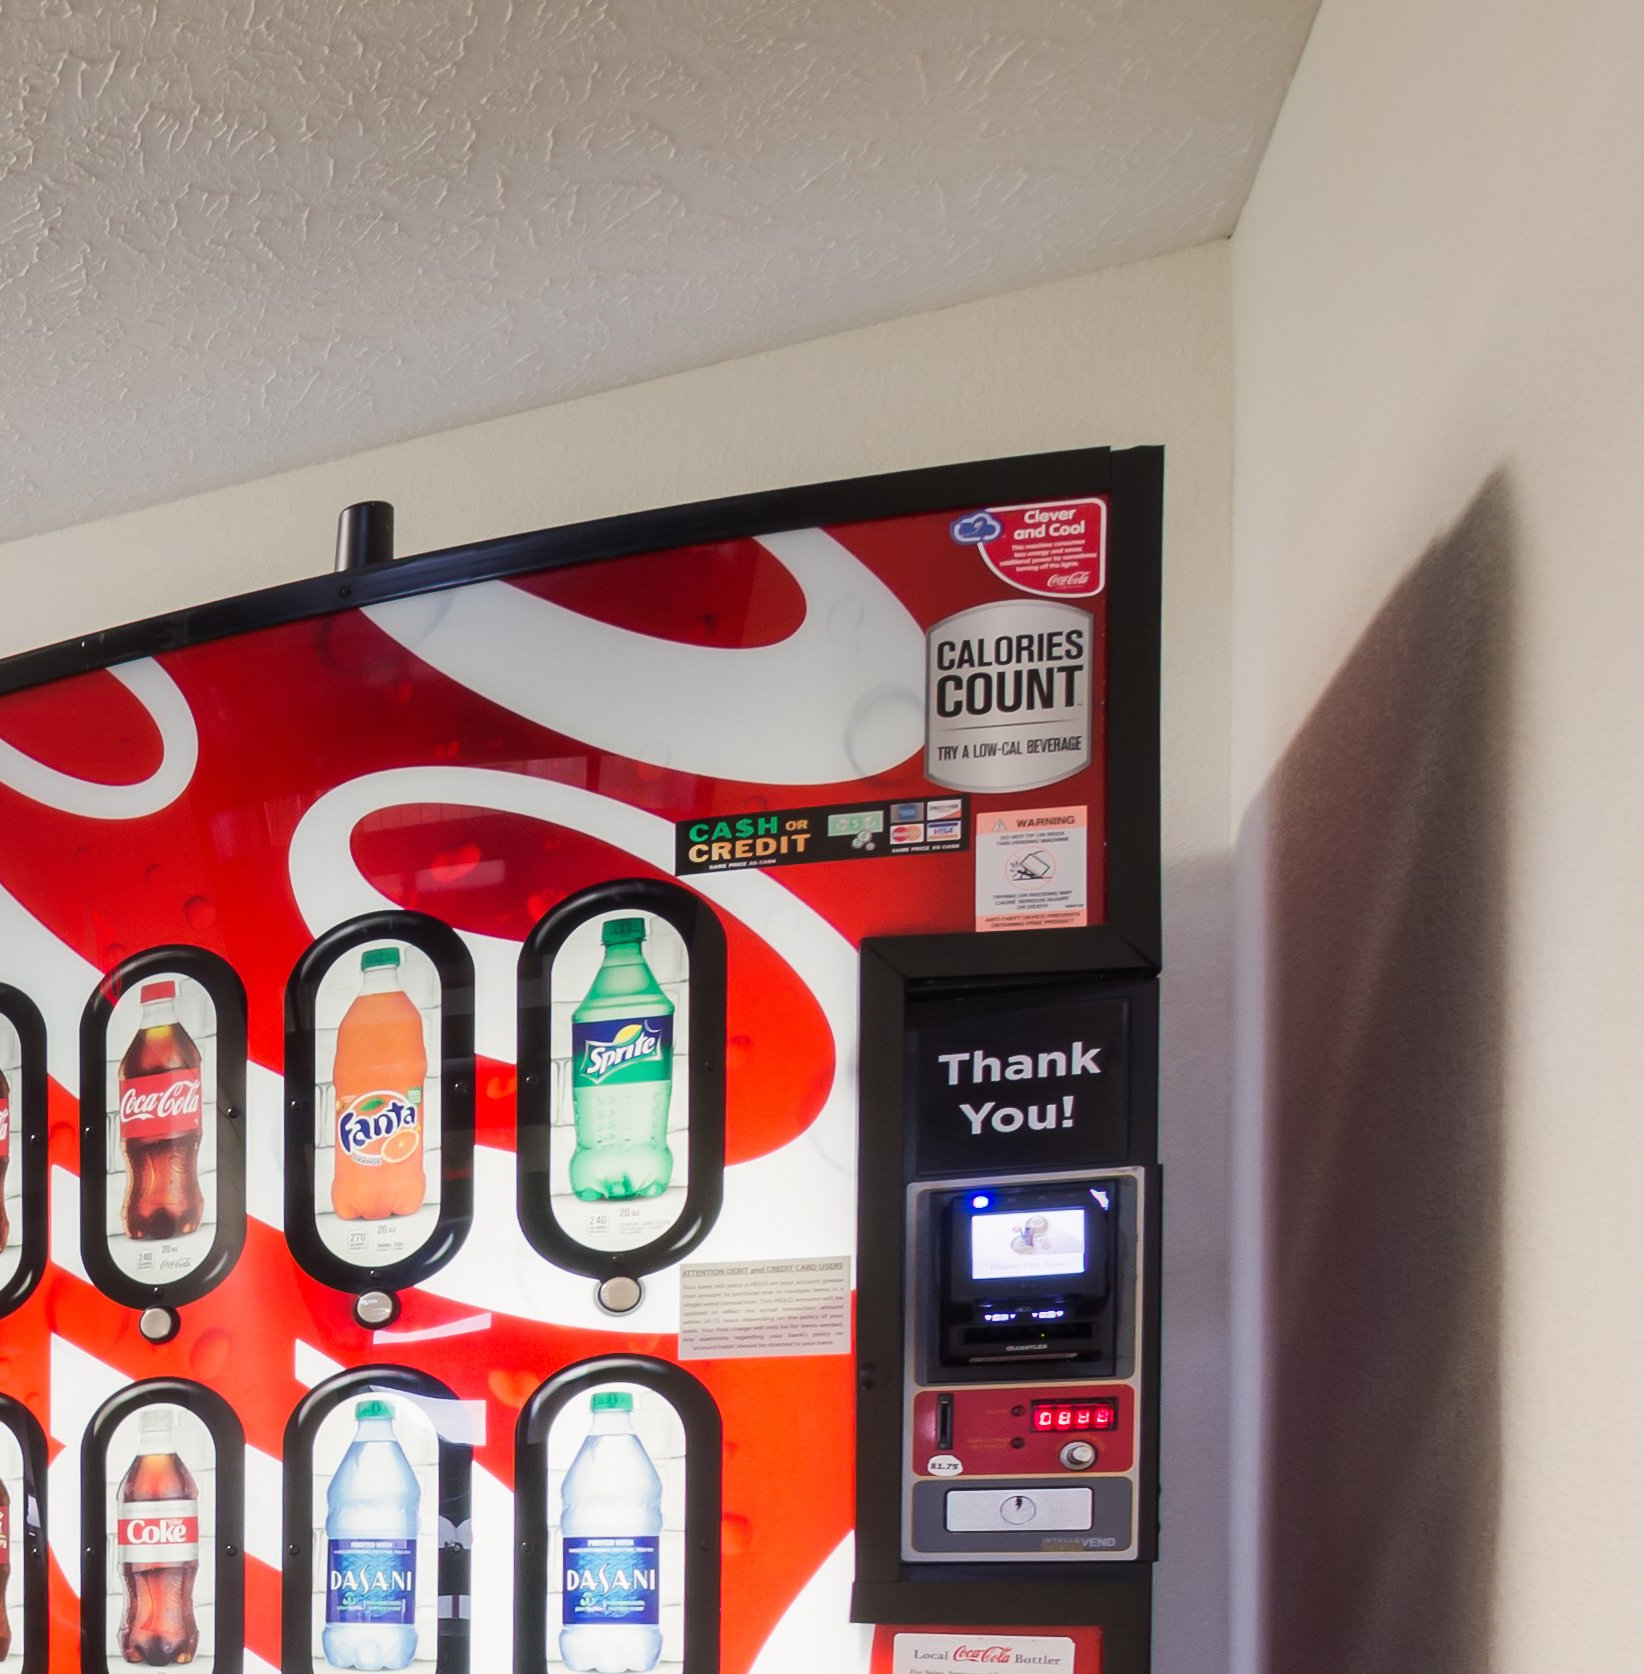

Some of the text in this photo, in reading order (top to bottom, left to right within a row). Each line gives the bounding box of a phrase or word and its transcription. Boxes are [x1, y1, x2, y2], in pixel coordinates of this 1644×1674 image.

[1014, 520, 1085, 540] and Cool
[1024, 509, 1076, 524] Clever
[936, 629, 1083, 671] CALORIES
[936, 664, 1084, 718] COUNT
[938, 736, 1082, 761] TRY A LOW-CAL BEVERAGE
[786, 820, 808, 831] OR
[1016, 816, 1075, 828] WARNING
[688, 834, 811, 863] CREDIT
[586, 1033, 657, 1077] Sprite
[938, 1041, 1102, 1085] Thank
[119, 1079, 201, 1123] Coca-Cola
[340, 1100, 415, 1152] Fanta
[959, 1096, 1074, 1134] You!
[683, 1262, 844, 1277] ATTENTION DEBIT and CREDIT CARD USERS
[127, 1519, 187, 1544] Coke
[330, 1566, 412, 1592] DASANI
[566, 1564, 656, 1593] DASANI
[914, 1645, 1061, 1665] Local Coca-Cola Bottler
